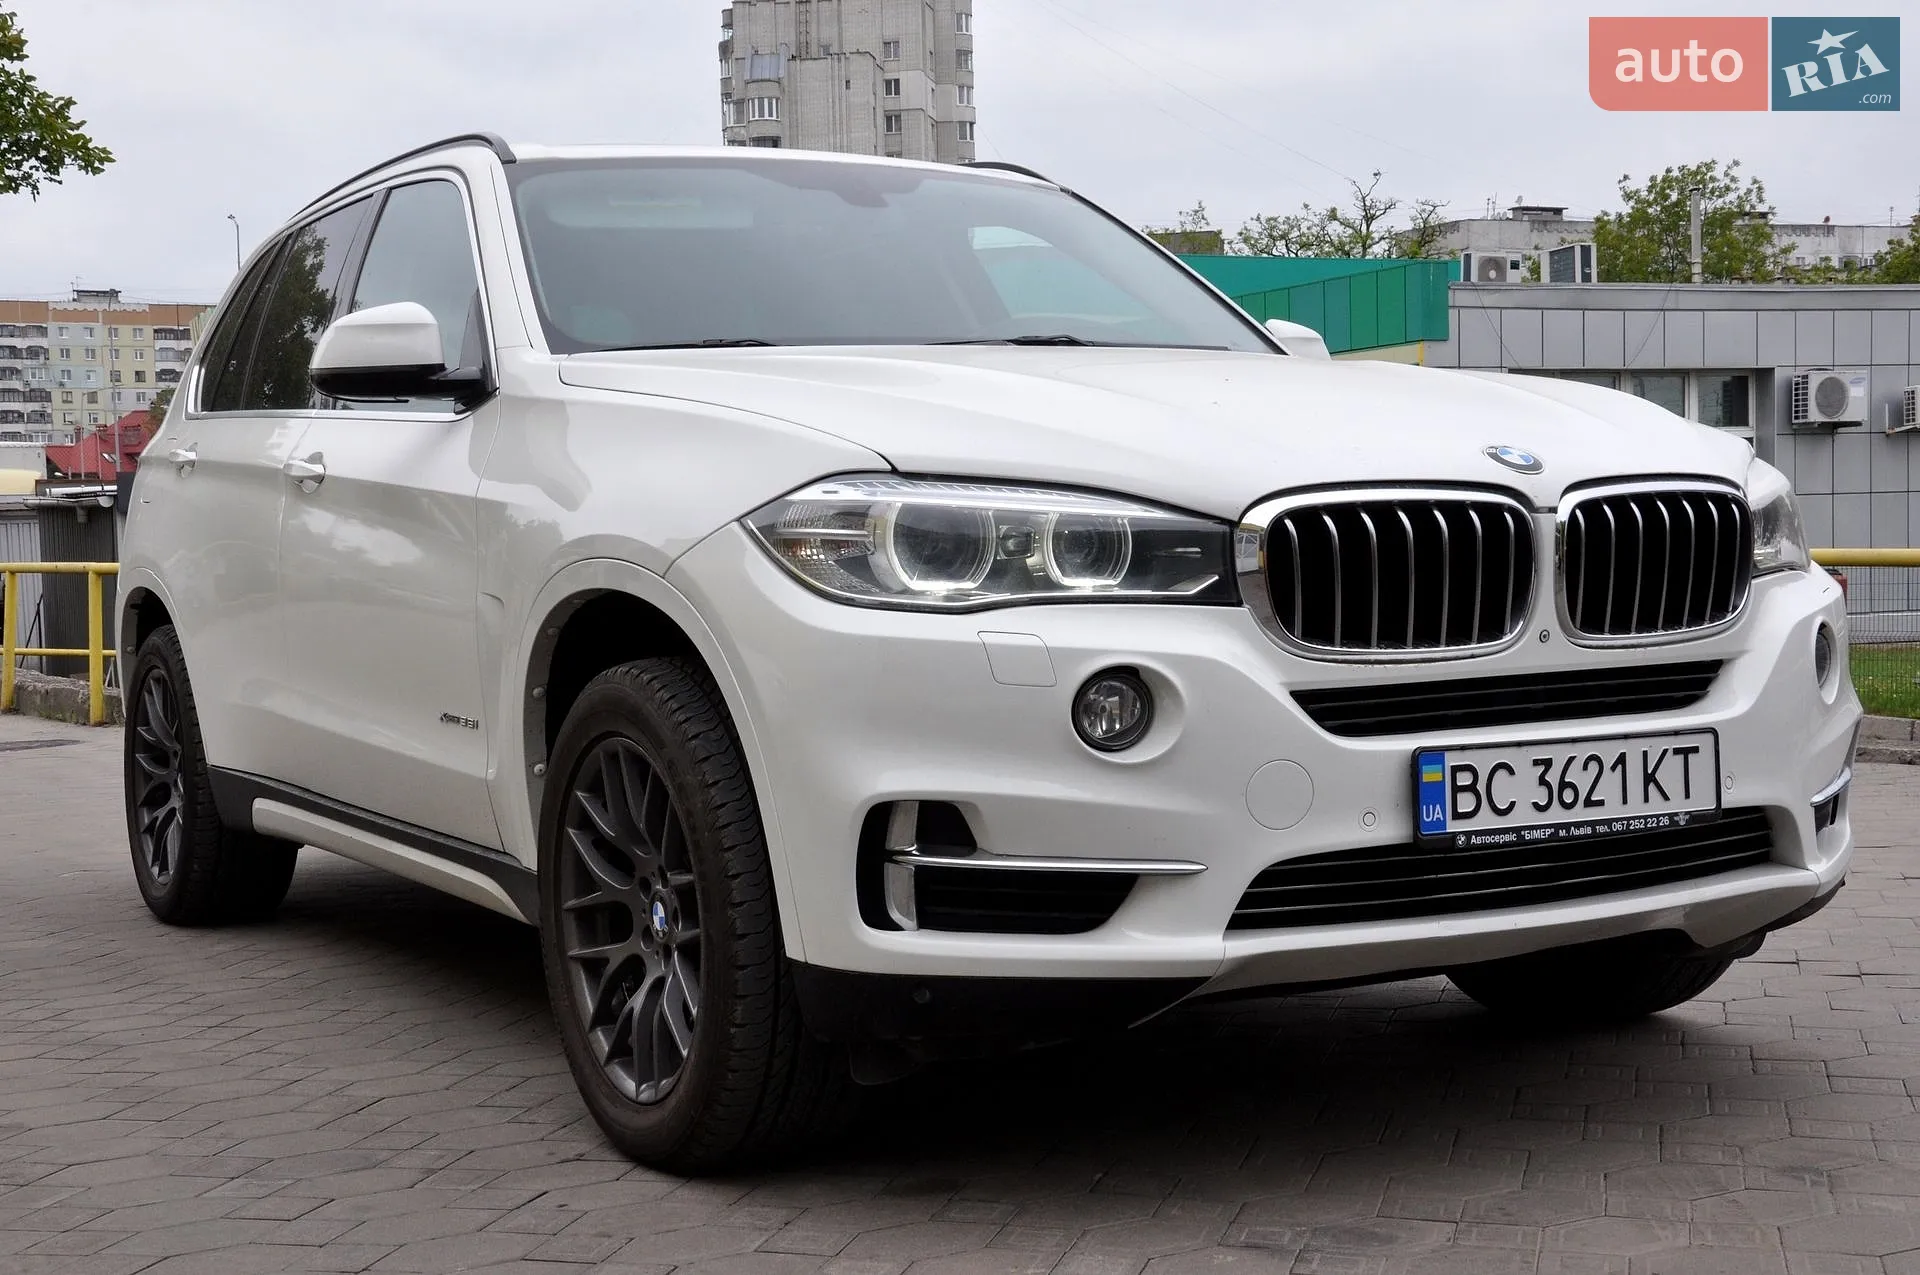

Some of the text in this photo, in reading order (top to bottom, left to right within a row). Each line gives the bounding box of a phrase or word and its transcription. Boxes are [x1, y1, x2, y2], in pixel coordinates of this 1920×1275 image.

[1450, 745, 1700, 820] BC 3621 KT
[1423, 804, 1443, 822] UA
[1470, 815, 1670, 845] Автосервіс "БІМЕР" м. Львів тел. 067 252 22 26
